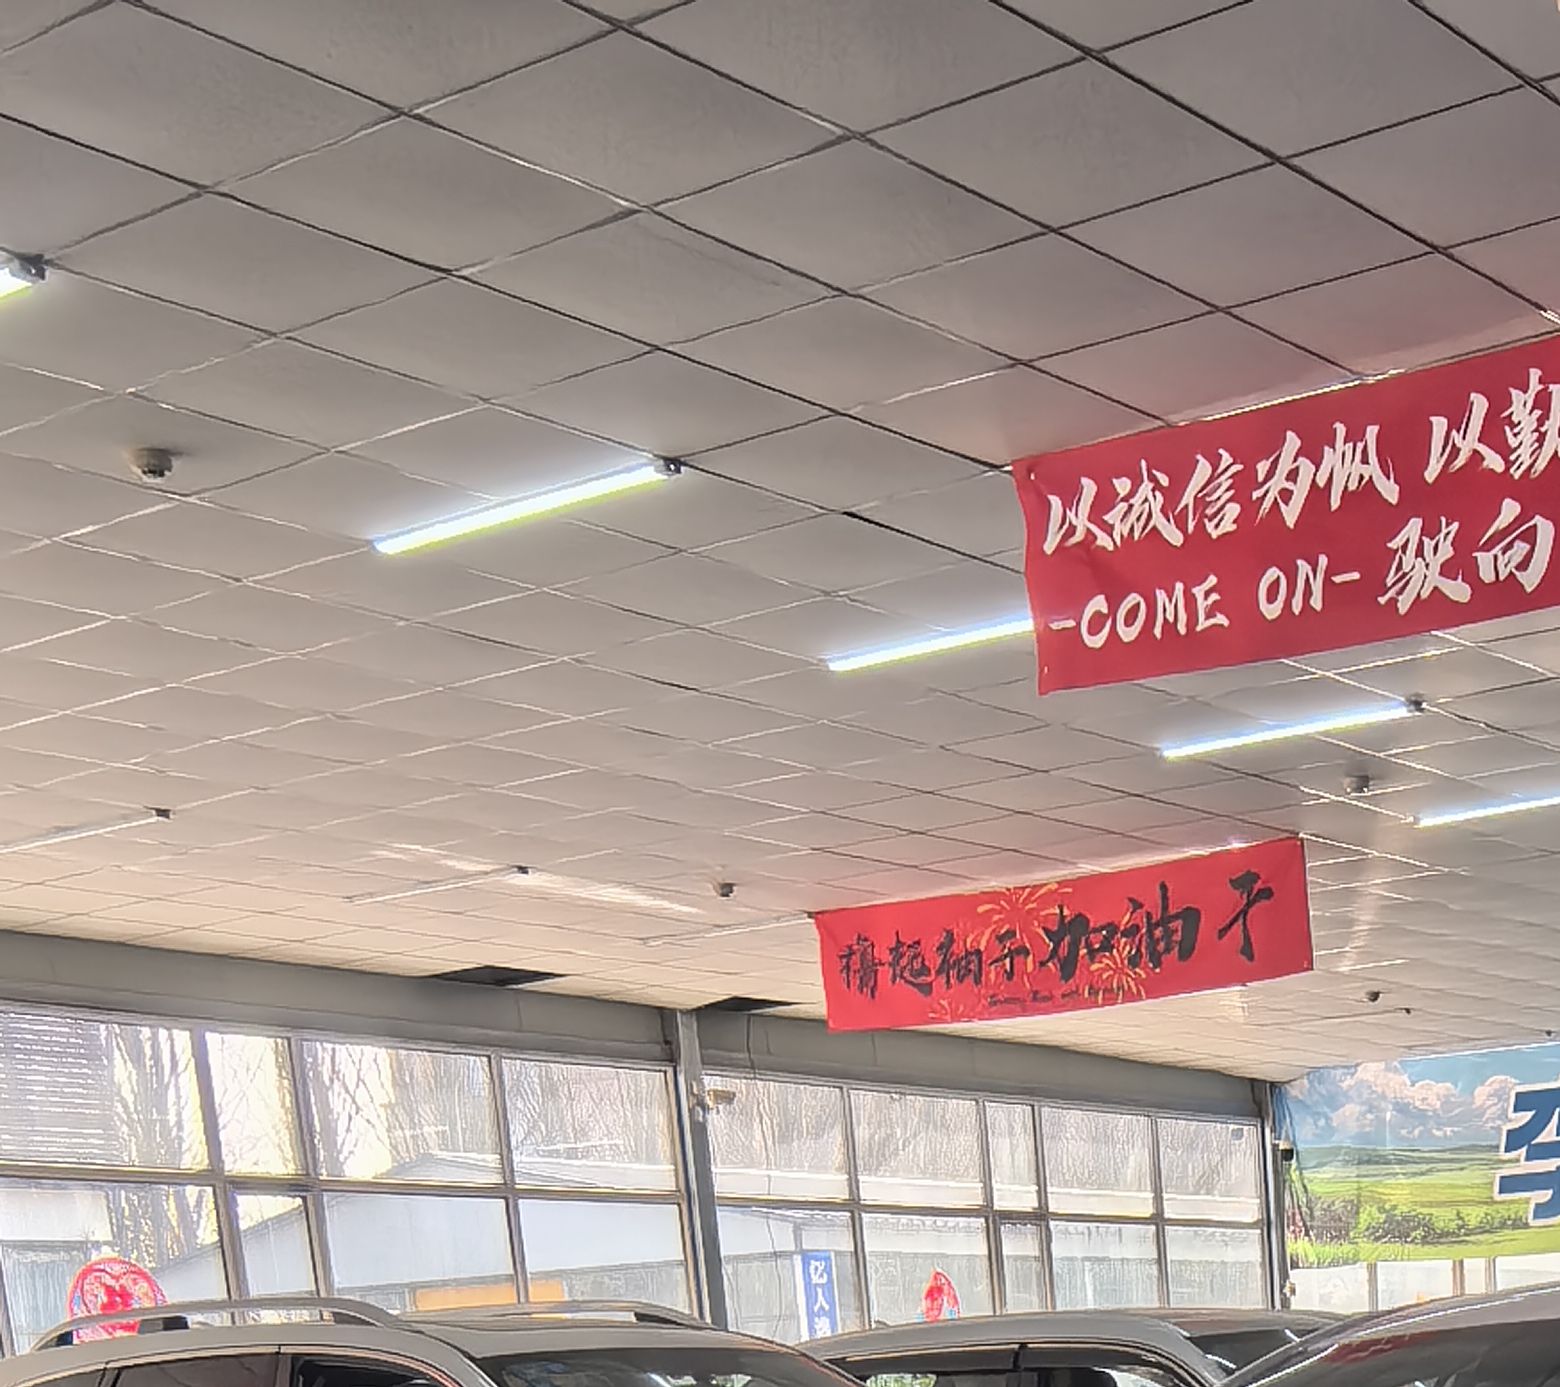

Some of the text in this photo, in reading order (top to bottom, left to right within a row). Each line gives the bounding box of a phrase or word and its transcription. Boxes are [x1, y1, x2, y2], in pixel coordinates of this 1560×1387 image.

[1041, 422, 1399, 556] 以诚信为帆
